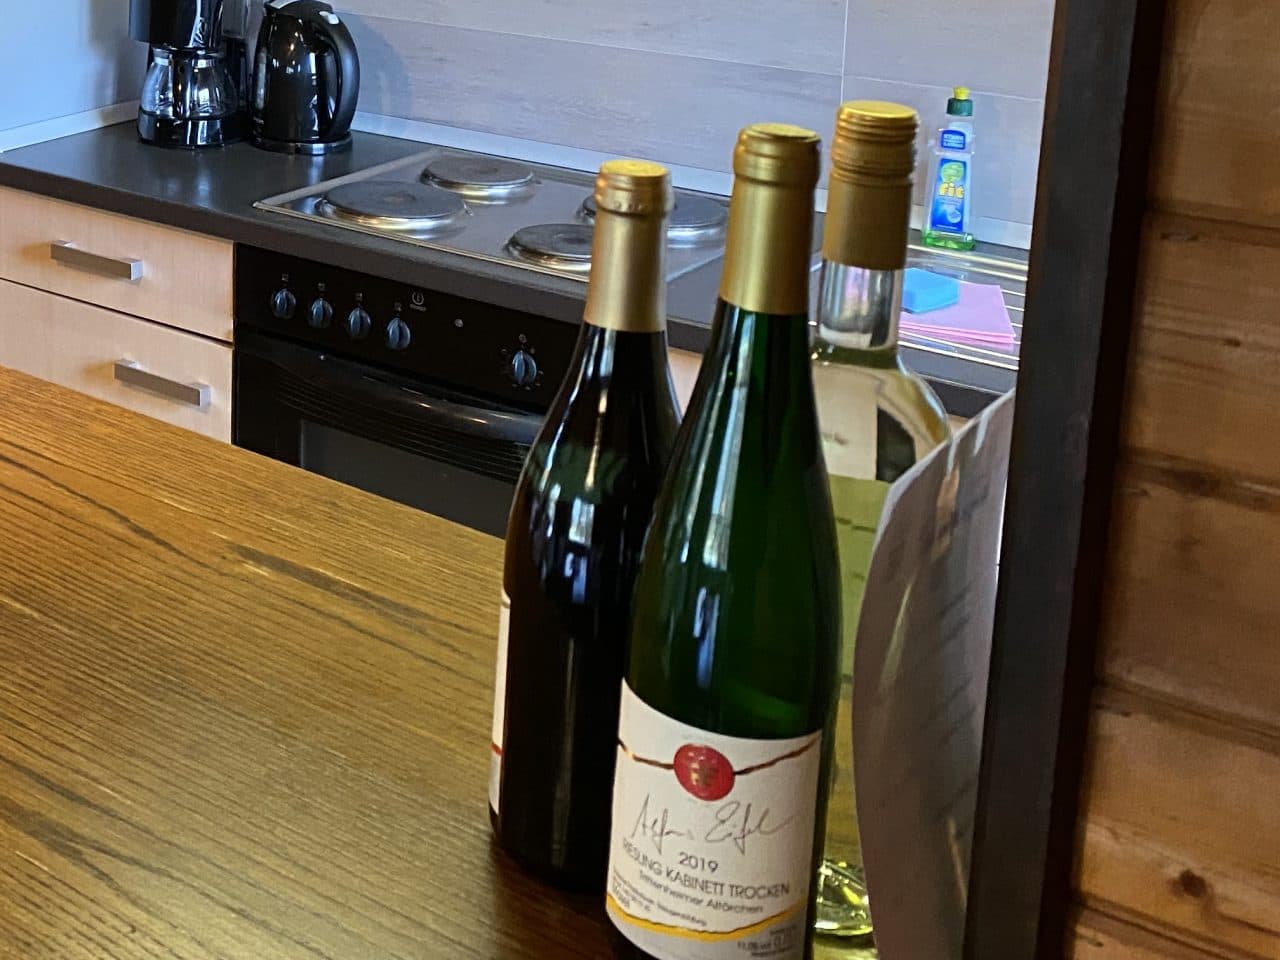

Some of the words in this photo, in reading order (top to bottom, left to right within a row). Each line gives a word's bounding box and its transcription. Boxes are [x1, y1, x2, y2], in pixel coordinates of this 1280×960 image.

[939, 182, 965, 198] fit
[679, 851, 719, 873] 2019
[665, 866, 725, 896] KABINETT
[728, 882, 790, 900] TROCKEN
